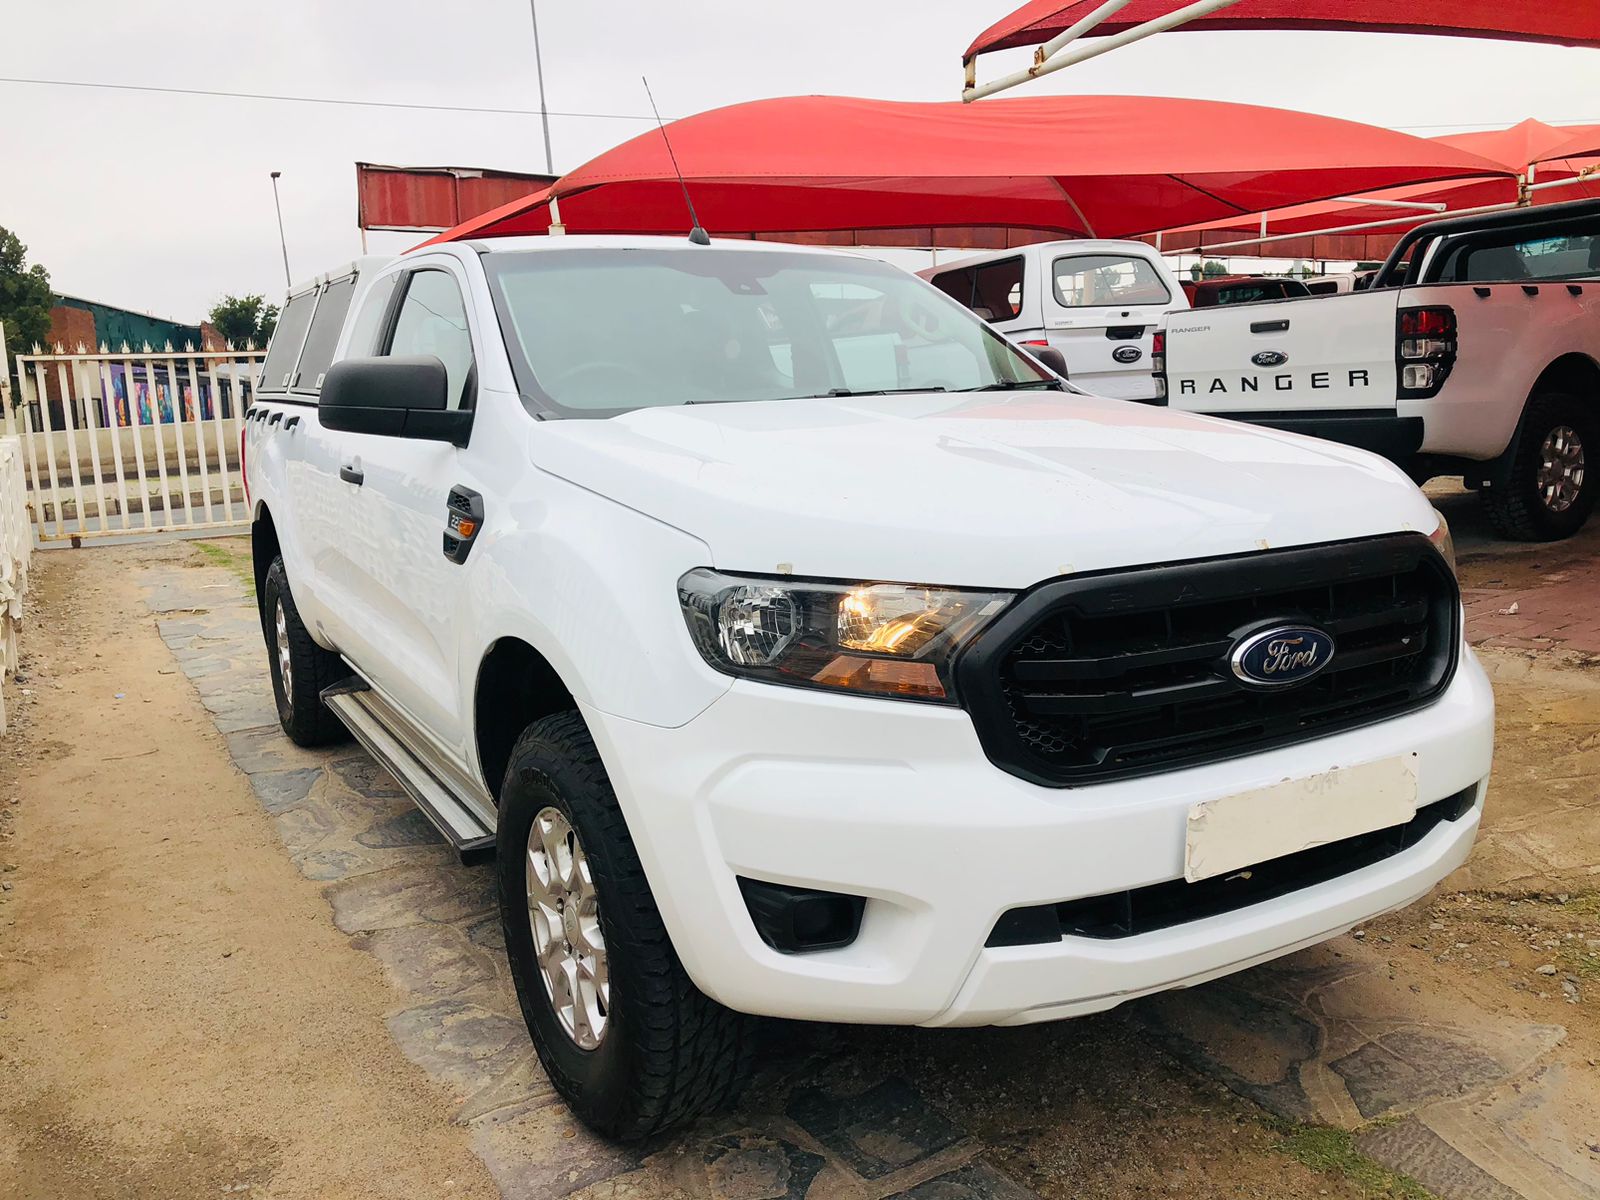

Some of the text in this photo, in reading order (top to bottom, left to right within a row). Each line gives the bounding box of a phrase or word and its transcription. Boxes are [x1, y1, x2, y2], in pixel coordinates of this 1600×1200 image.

[1171, 326, 1211, 334] RANGER
[1180, 370, 1369, 394] RANGER
[1263, 636, 1318, 674] Ford
